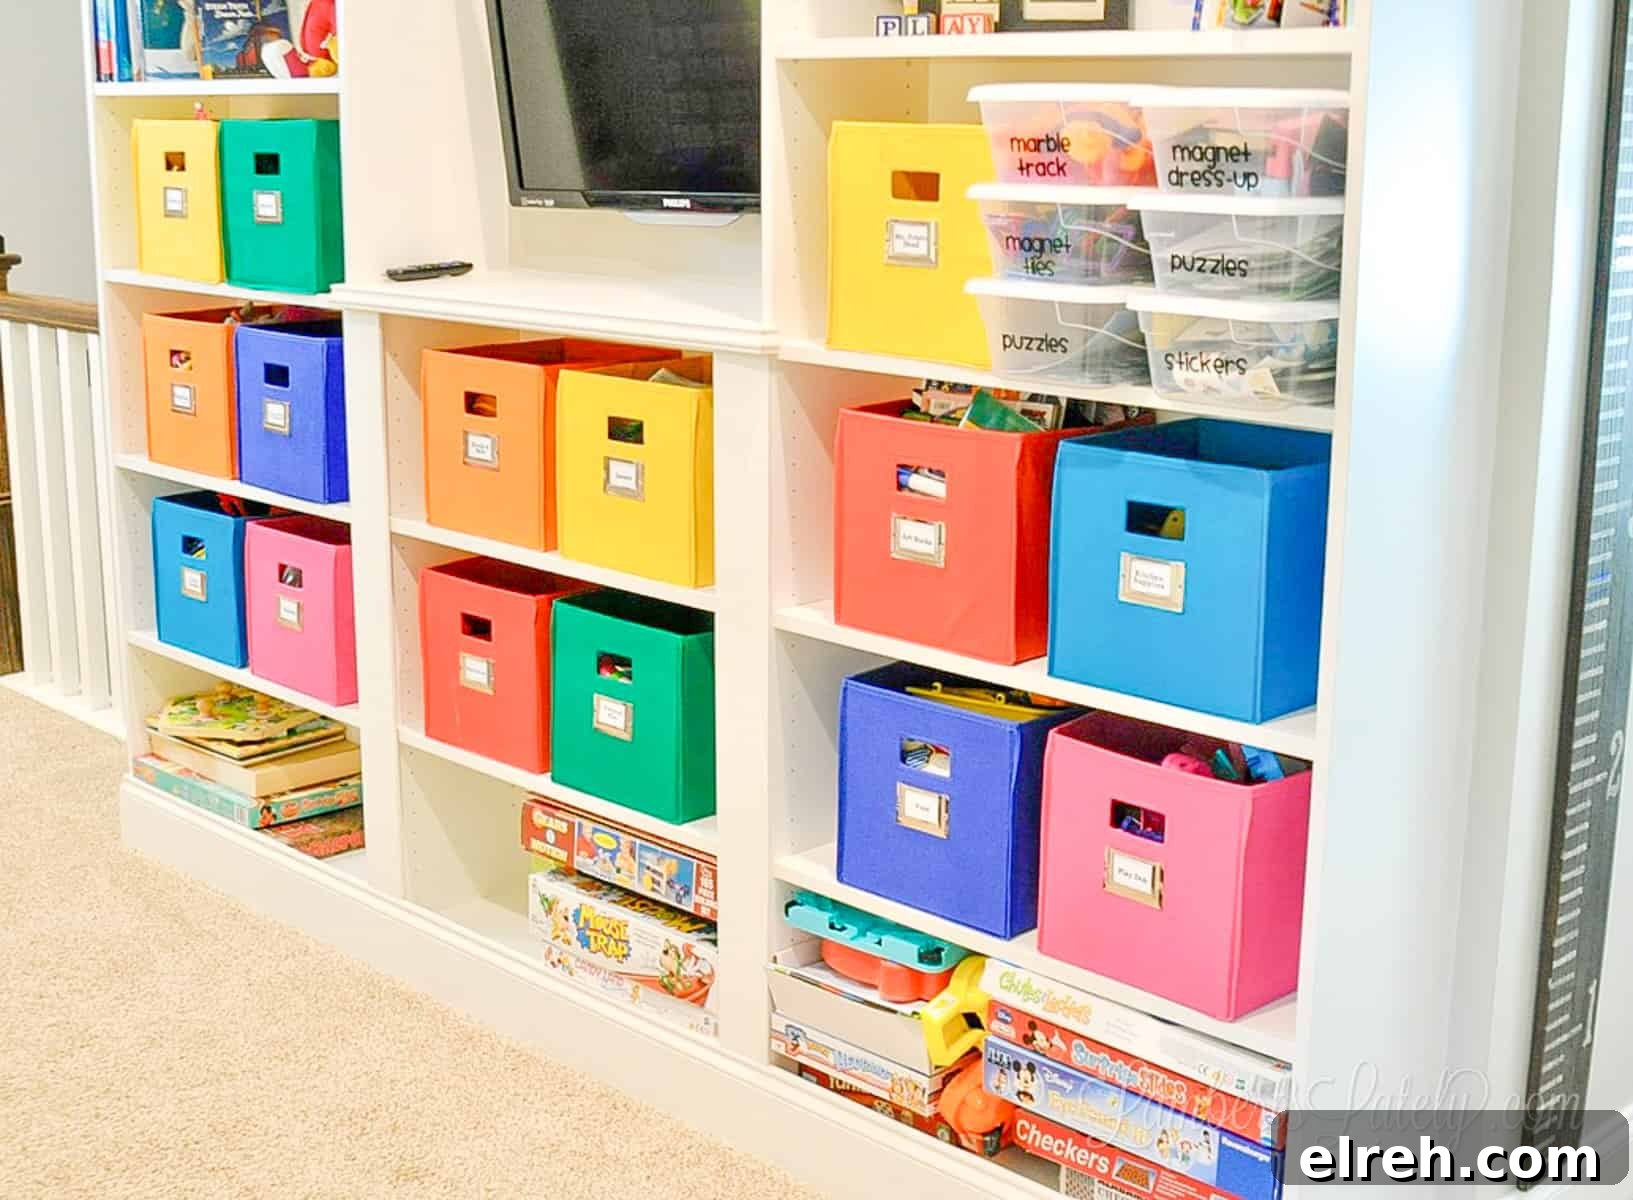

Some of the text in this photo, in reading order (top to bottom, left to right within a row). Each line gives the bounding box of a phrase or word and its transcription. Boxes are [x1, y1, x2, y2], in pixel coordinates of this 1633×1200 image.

[1010, 132, 1071, 153] marble
[1018, 157, 1067, 177] track
[1171, 141, 1252, 169] magnet
[1167, 166, 1258, 190] dress-up
[1006, 234, 1072, 259] magnet
[1170, 253, 1248, 278] puzzles
[1002, 332, 1069, 353] puzzles
[1164, 351, 1248, 375] stickers
[1014, 1118, 1111, 1174] Checkers
